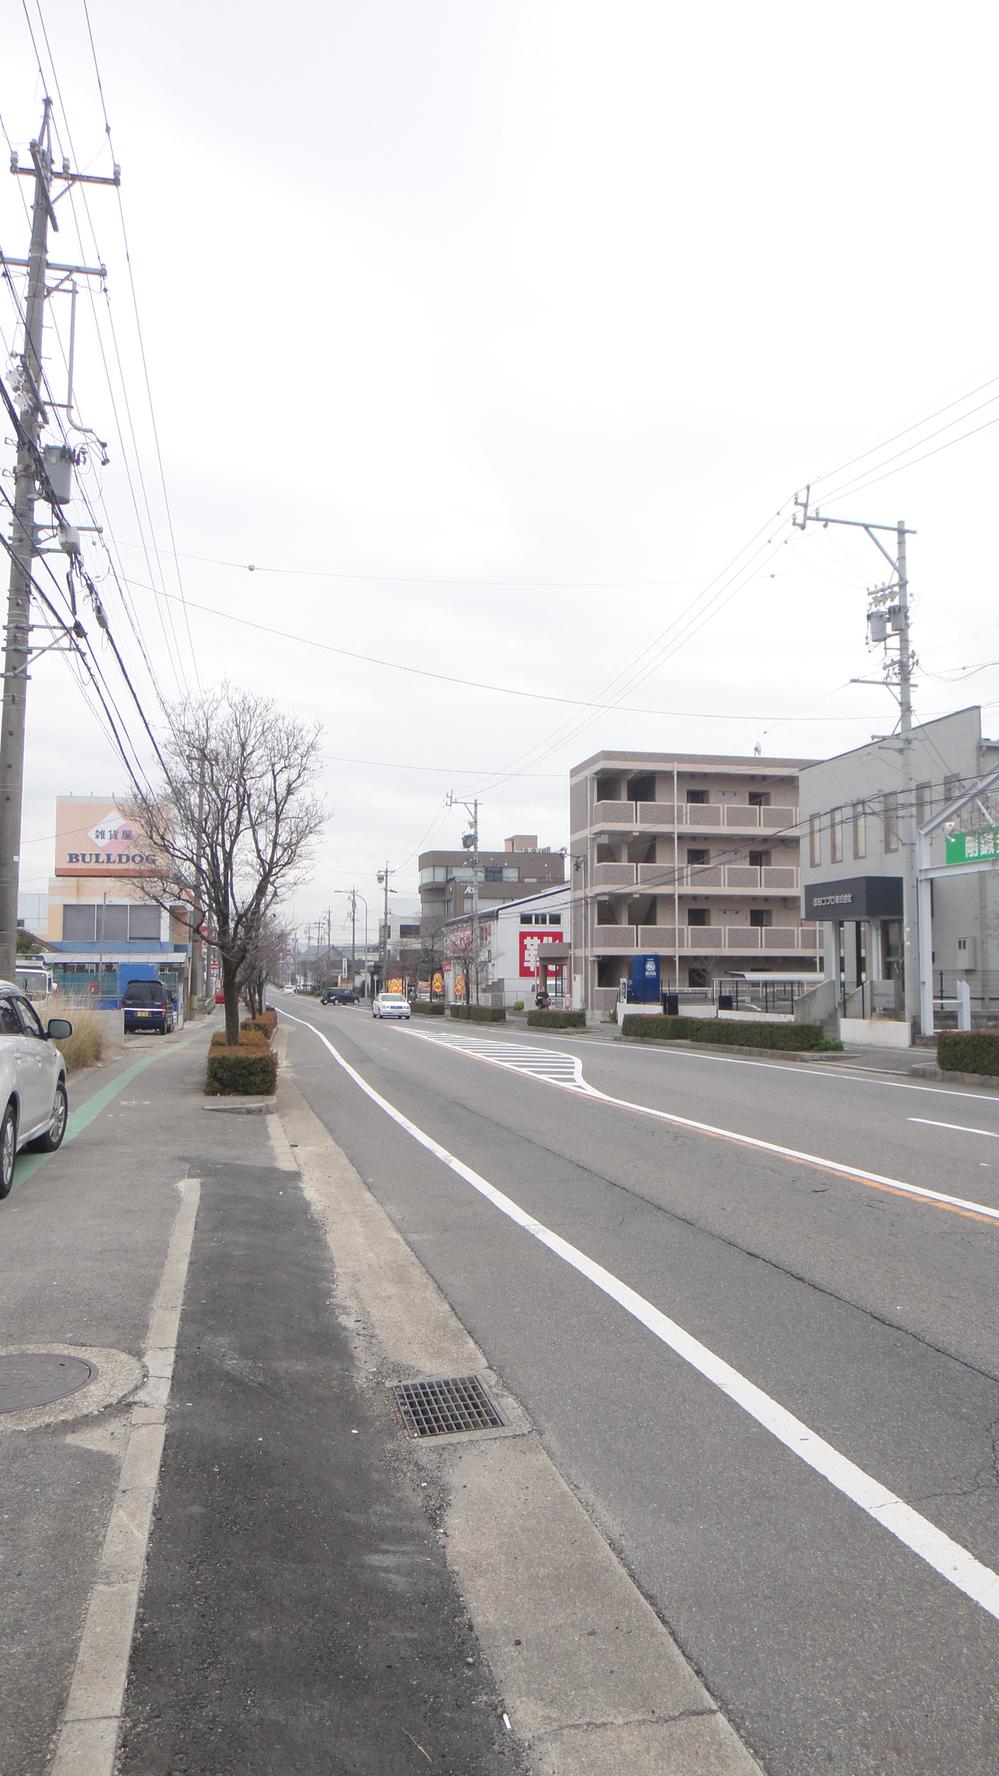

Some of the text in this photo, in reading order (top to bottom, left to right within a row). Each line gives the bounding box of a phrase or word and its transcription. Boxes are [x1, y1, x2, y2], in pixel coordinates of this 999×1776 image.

[94, 828, 132, 840] 雑貨屋
[67, 852, 157, 864] BULLDOG
